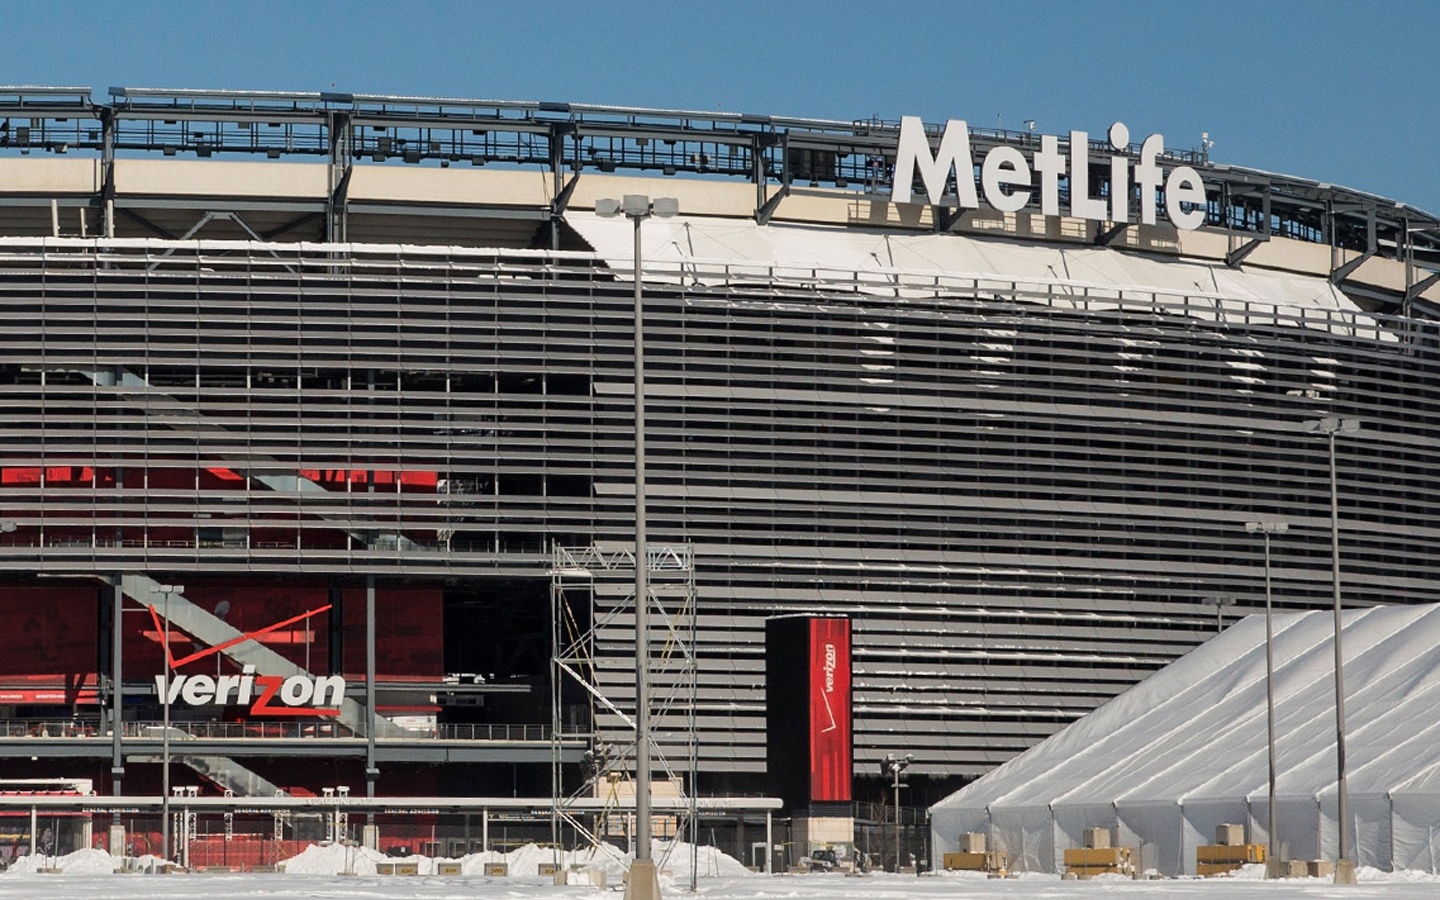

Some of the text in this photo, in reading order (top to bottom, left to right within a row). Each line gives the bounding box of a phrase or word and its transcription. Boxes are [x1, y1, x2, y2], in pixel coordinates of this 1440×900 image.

[891, 115, 1207, 230] MetLife
[155, 664, 346, 716] verizon
[823, 643, 836, 693] verizon
